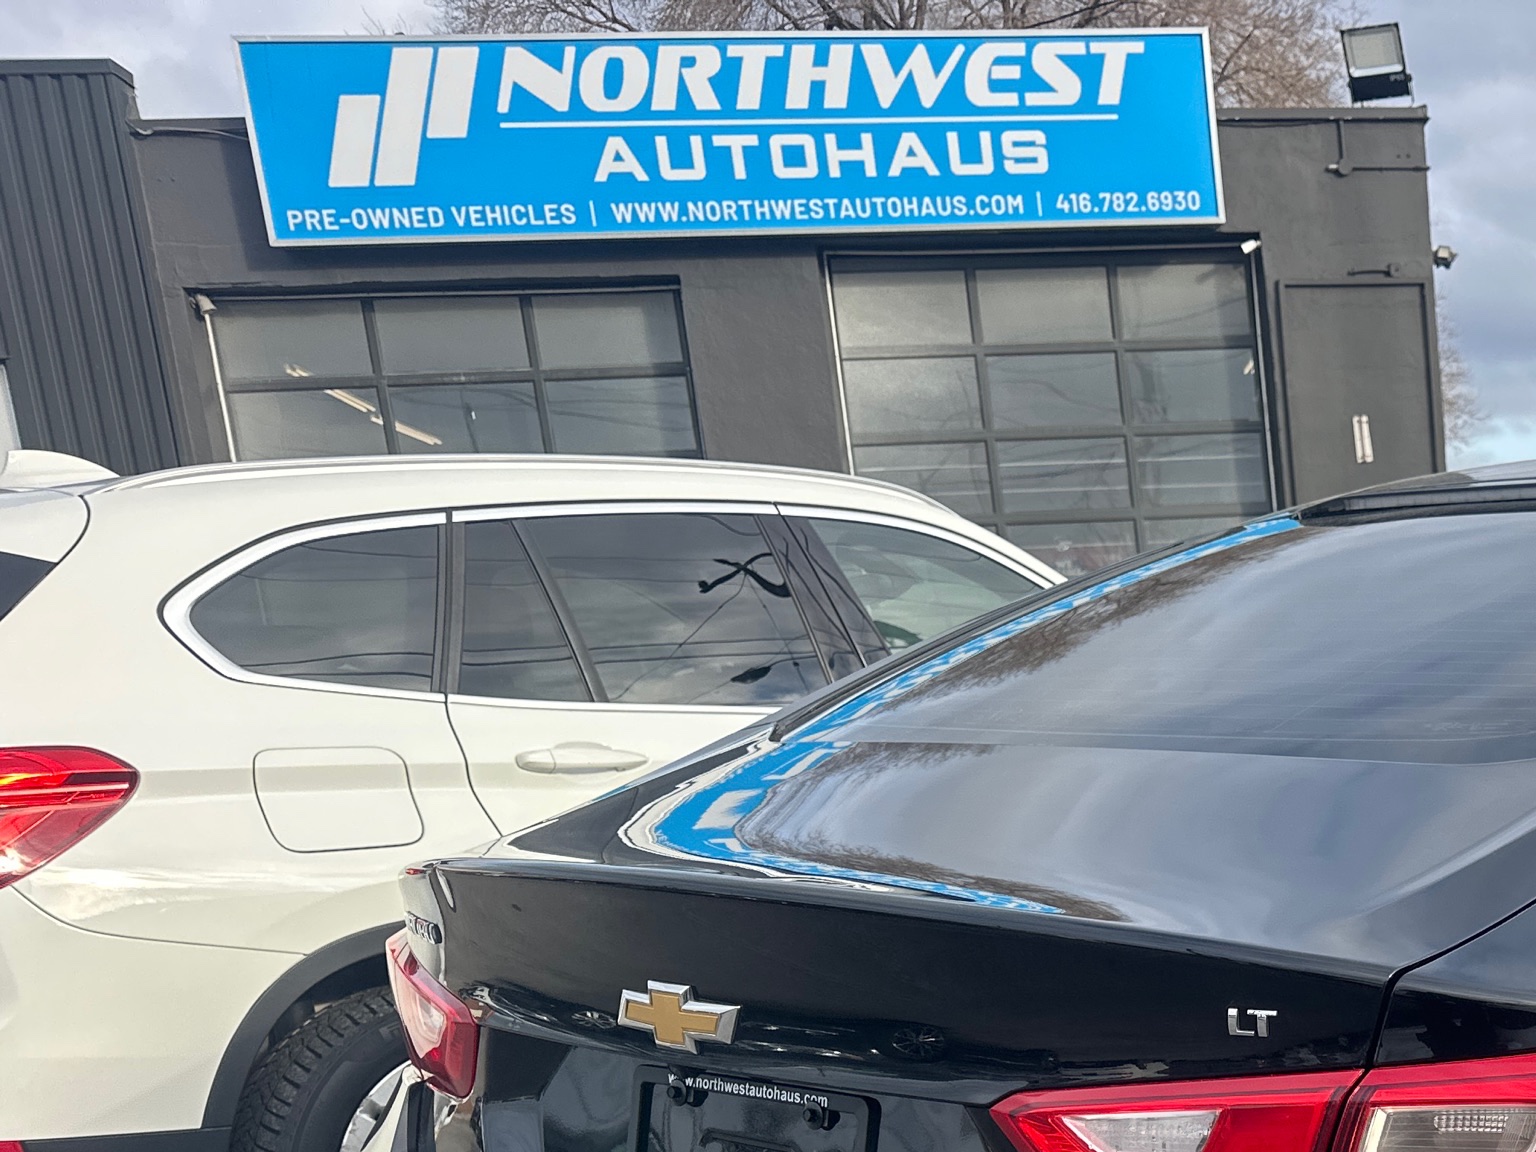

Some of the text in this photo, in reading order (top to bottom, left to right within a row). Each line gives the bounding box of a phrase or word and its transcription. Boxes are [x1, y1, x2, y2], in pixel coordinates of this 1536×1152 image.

[497, 41, 1145, 114] NORTHWEST
[594, 129, 1049, 182] AUTOHAUS
[286, 191, 1201, 231] PRE-OWNED VEHICLES WWW.NORTHWESTAUTOHAUS.COM 416.782.6930
[1227, 1007, 1278, 1037] LT
